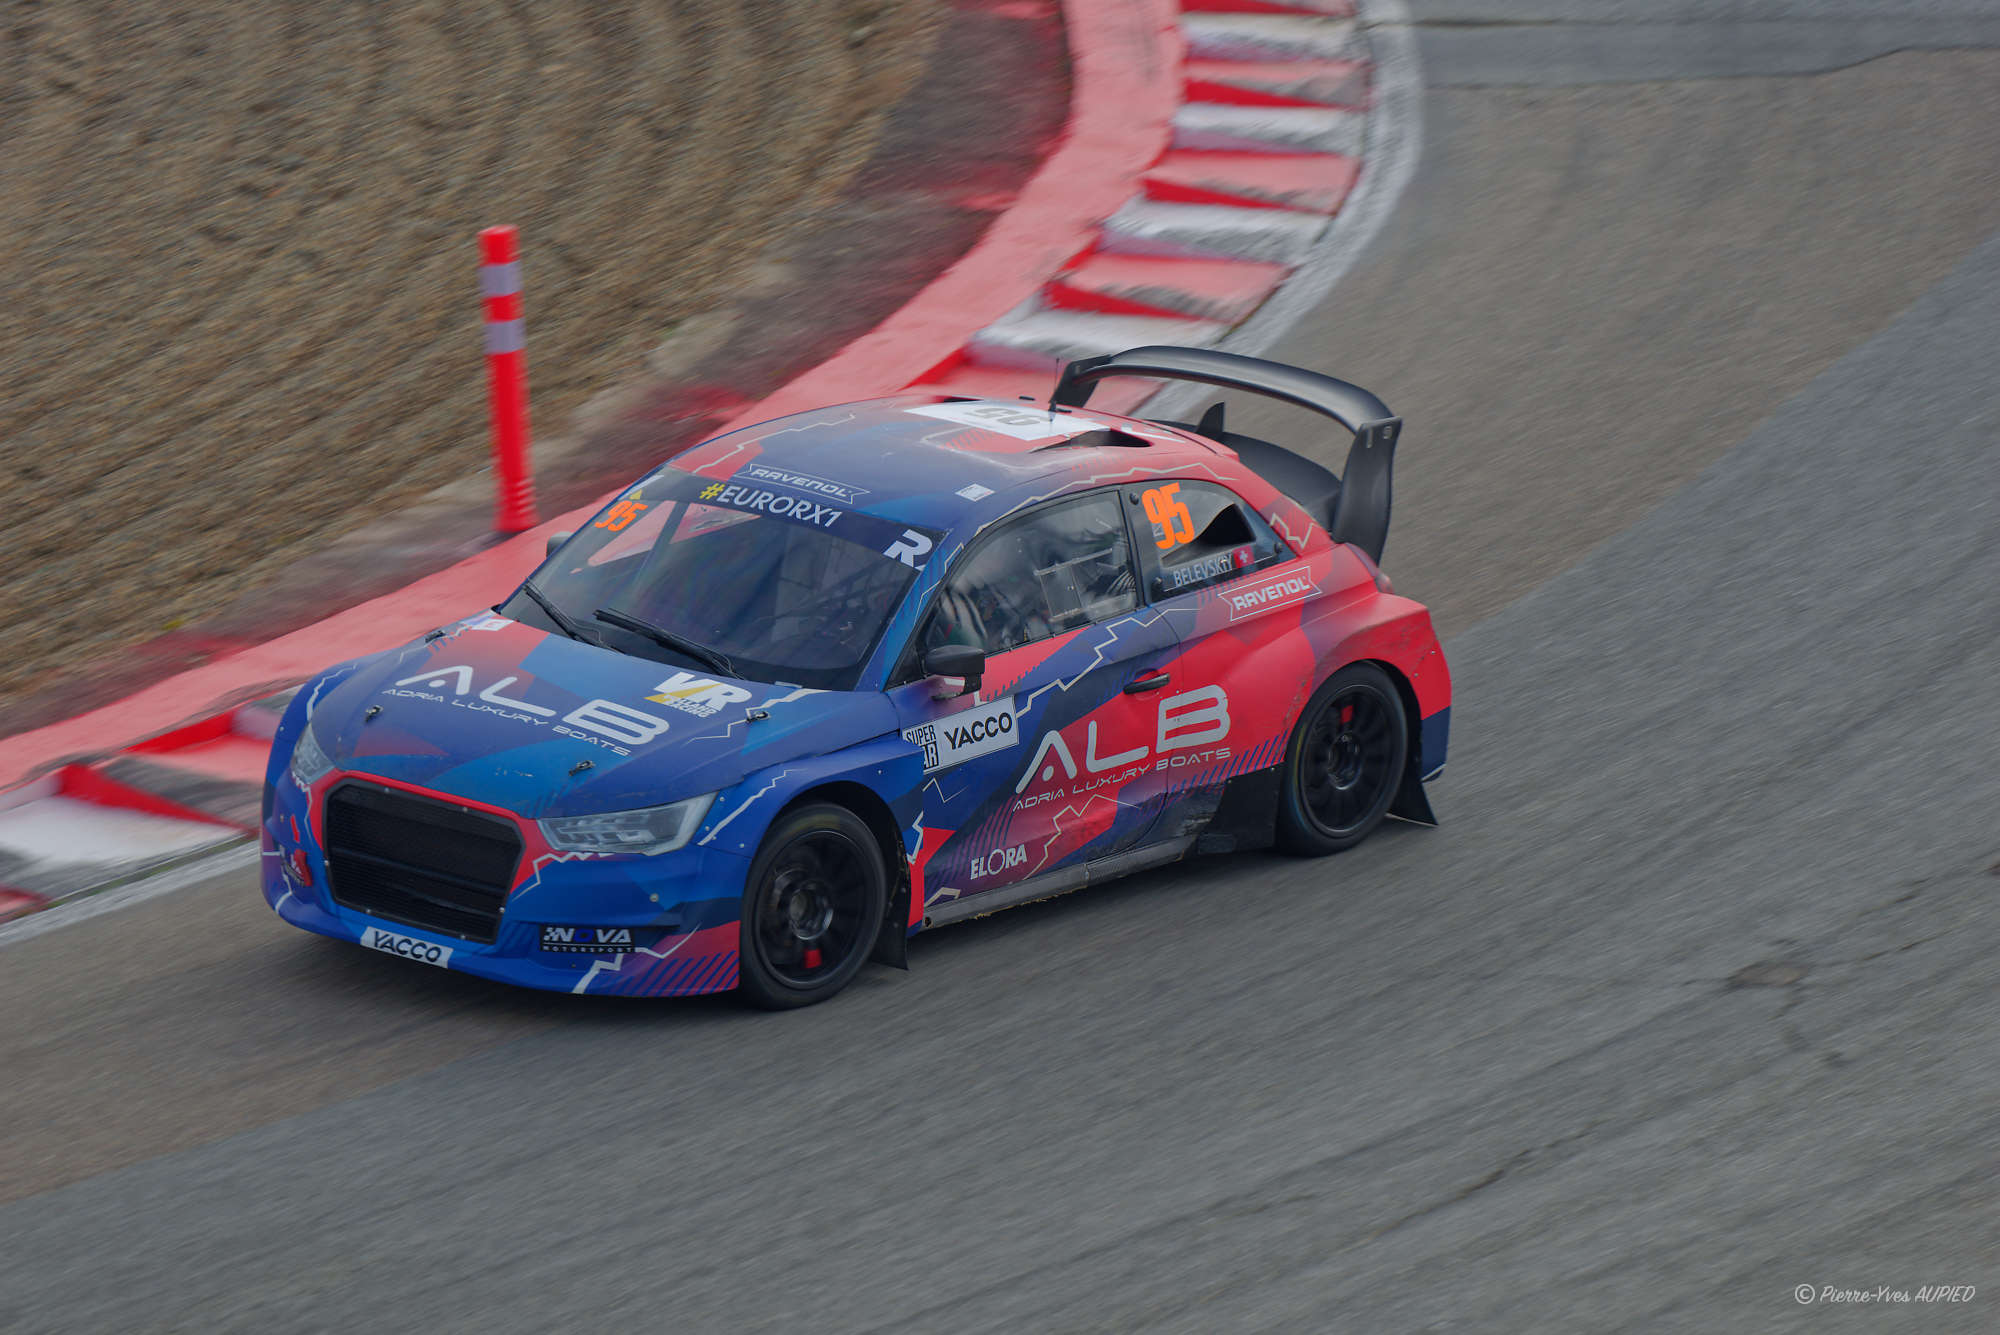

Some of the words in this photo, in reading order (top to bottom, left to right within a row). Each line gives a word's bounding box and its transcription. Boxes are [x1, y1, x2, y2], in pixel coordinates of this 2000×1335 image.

[751, 469, 849, 497] RAVENOL
[594, 500, 648, 532] 95
[699, 483, 842, 527] #EURORX1
[1141, 482, 1195, 549] 95
[1231, 577, 1310, 611] RAVENOL
[381, 688, 445, 703] ADRIA
[452, 699, 549, 726] LUXURY
[552, 725, 632, 757] BOATS
[395, 665, 670, 745] ALB
[906, 724, 936, 744] SUPER
[944, 712, 1012, 750] YACCO
[1015, 684, 1231, 793] ALB
[1012, 788, 1065, 812] ADRIA
[1072, 764, 1152, 794] LUXURY
[1156, 747, 1231, 771] BOATS
[970, 843, 1027, 880] ELORA
[374, 930, 442, 963] YACCO
